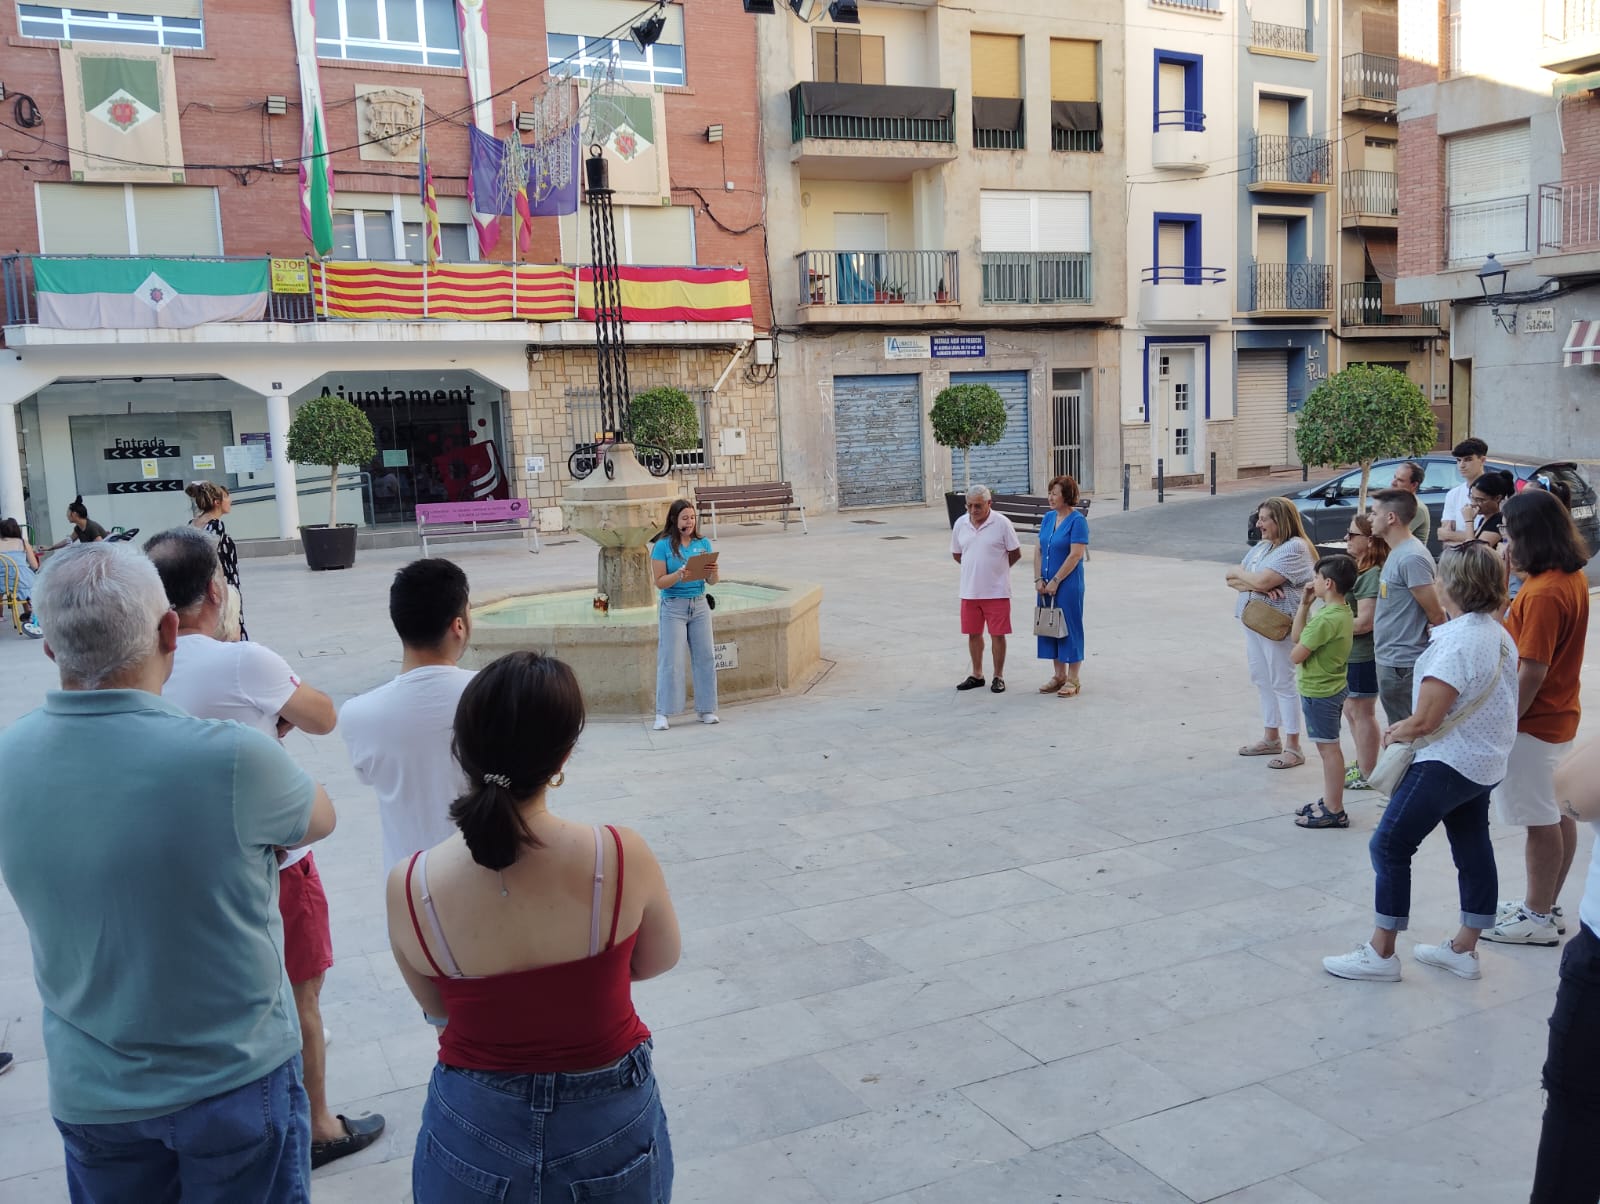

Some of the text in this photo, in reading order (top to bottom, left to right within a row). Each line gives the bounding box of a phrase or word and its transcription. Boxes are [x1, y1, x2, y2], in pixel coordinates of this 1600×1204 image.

[273, 260, 305, 269] STOP
[320, 385, 476, 408] Ajuntament
[115, 437, 166, 449] Entrada
